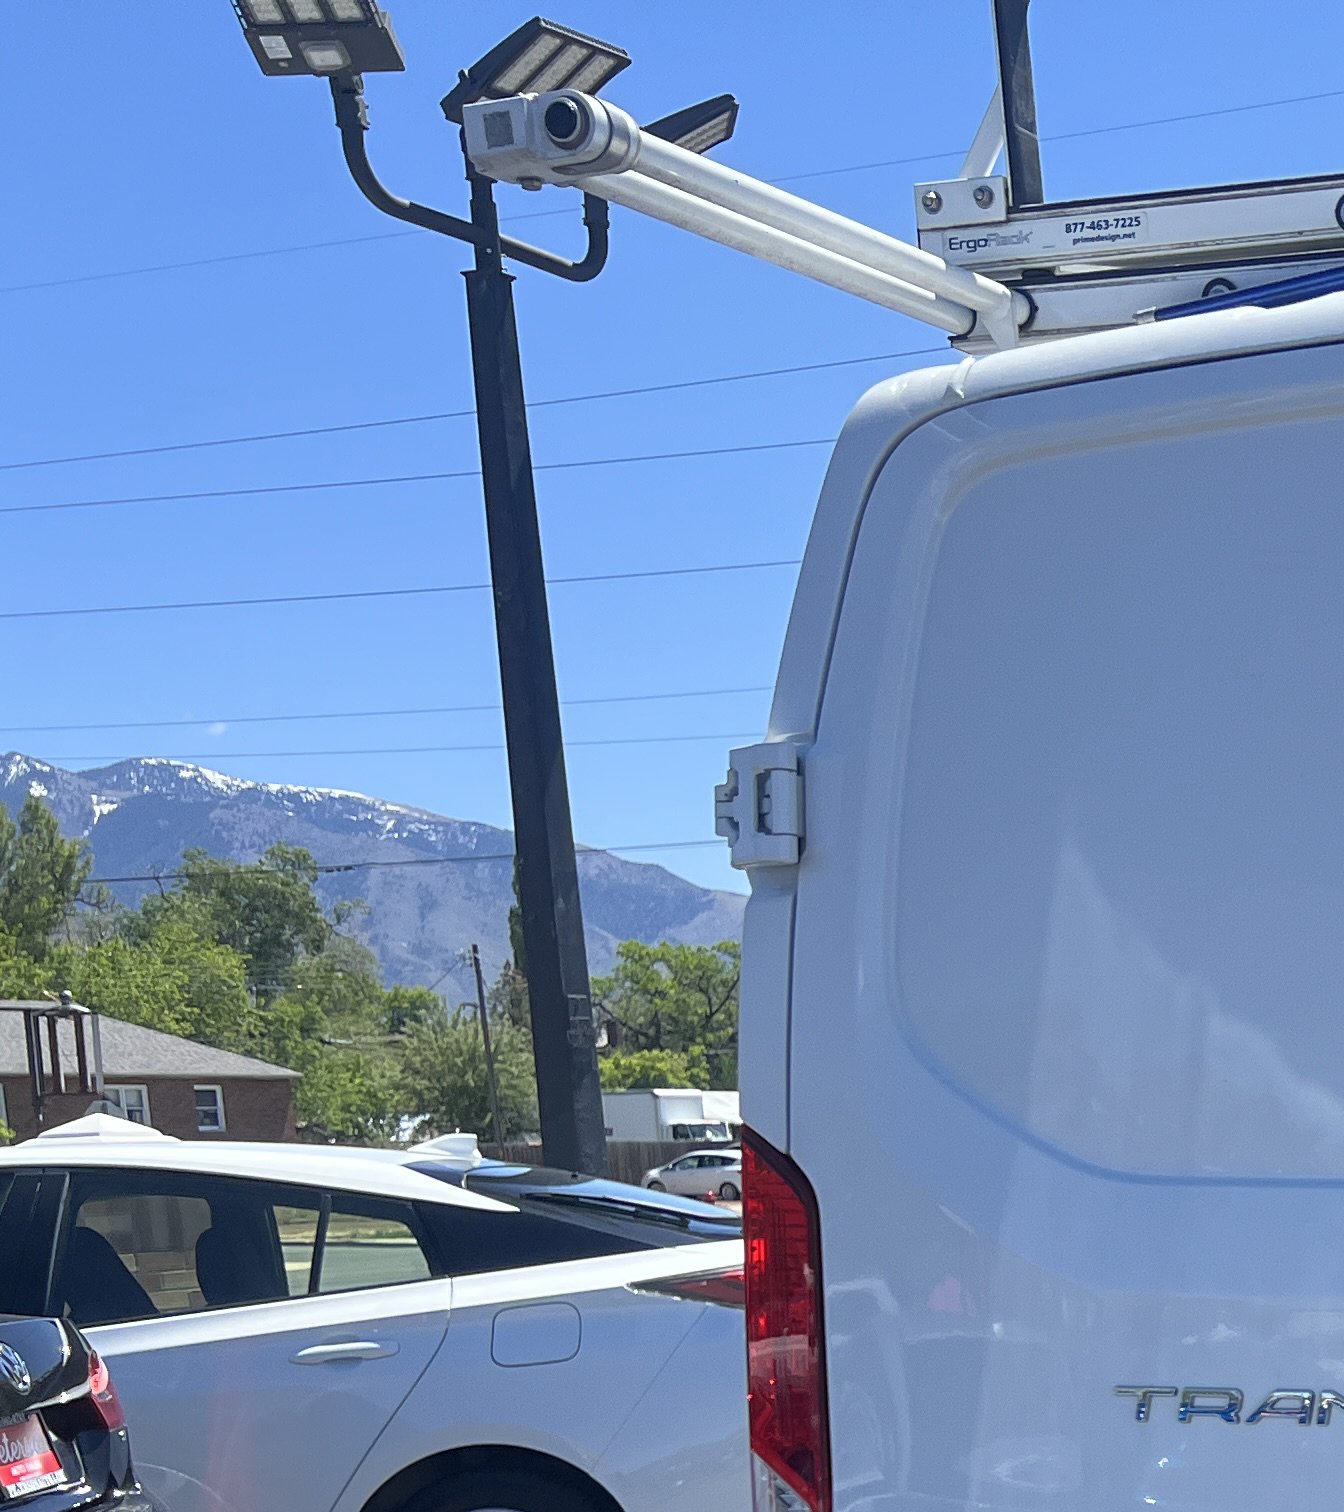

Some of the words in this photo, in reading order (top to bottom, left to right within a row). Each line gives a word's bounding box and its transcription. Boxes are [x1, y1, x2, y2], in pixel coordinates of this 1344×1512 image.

[1065, 216, 1141, 234] 877-463-7225
[949, 230, 1033, 253] ErgoRack
[1072, 232, 1136, 246] primedesign.net
